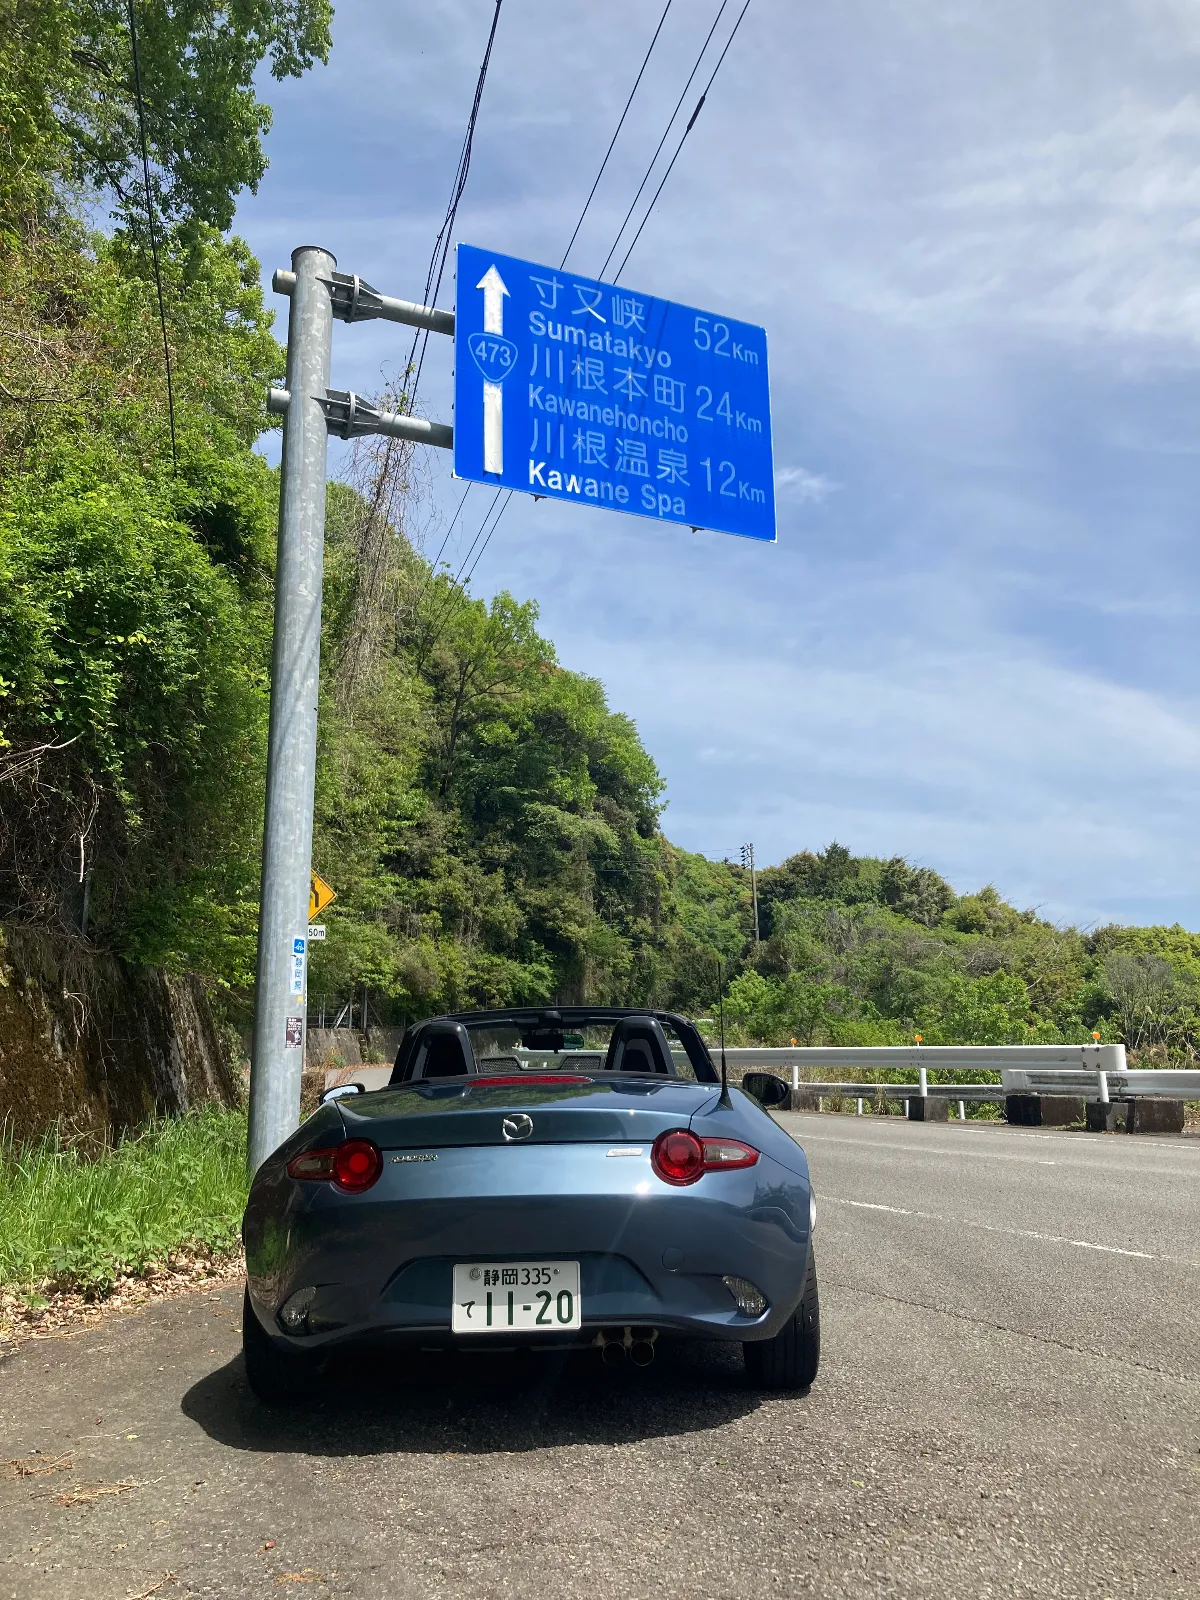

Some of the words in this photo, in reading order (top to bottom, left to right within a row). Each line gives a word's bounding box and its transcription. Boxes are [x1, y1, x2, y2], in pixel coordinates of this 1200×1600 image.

[529, 276, 646, 333] 寸又峡
[475, 340, 511, 367] 473
[529, 311, 672, 369] Sumatakyo
[529, 344, 686, 413] 川根本町
[529, 383, 689, 443] Kawanehoncho
[530, 418, 690, 486] 川根温泉
[529, 459, 630, 503] Kawane
[641, 483, 686, 516] Spa
[483, 1268, 519, 1287] 静岡
[520, 1267, 552, 1286] 335
[460, 1300, 476, 1319] て
[486, 1289, 574, 1327] 11-20
